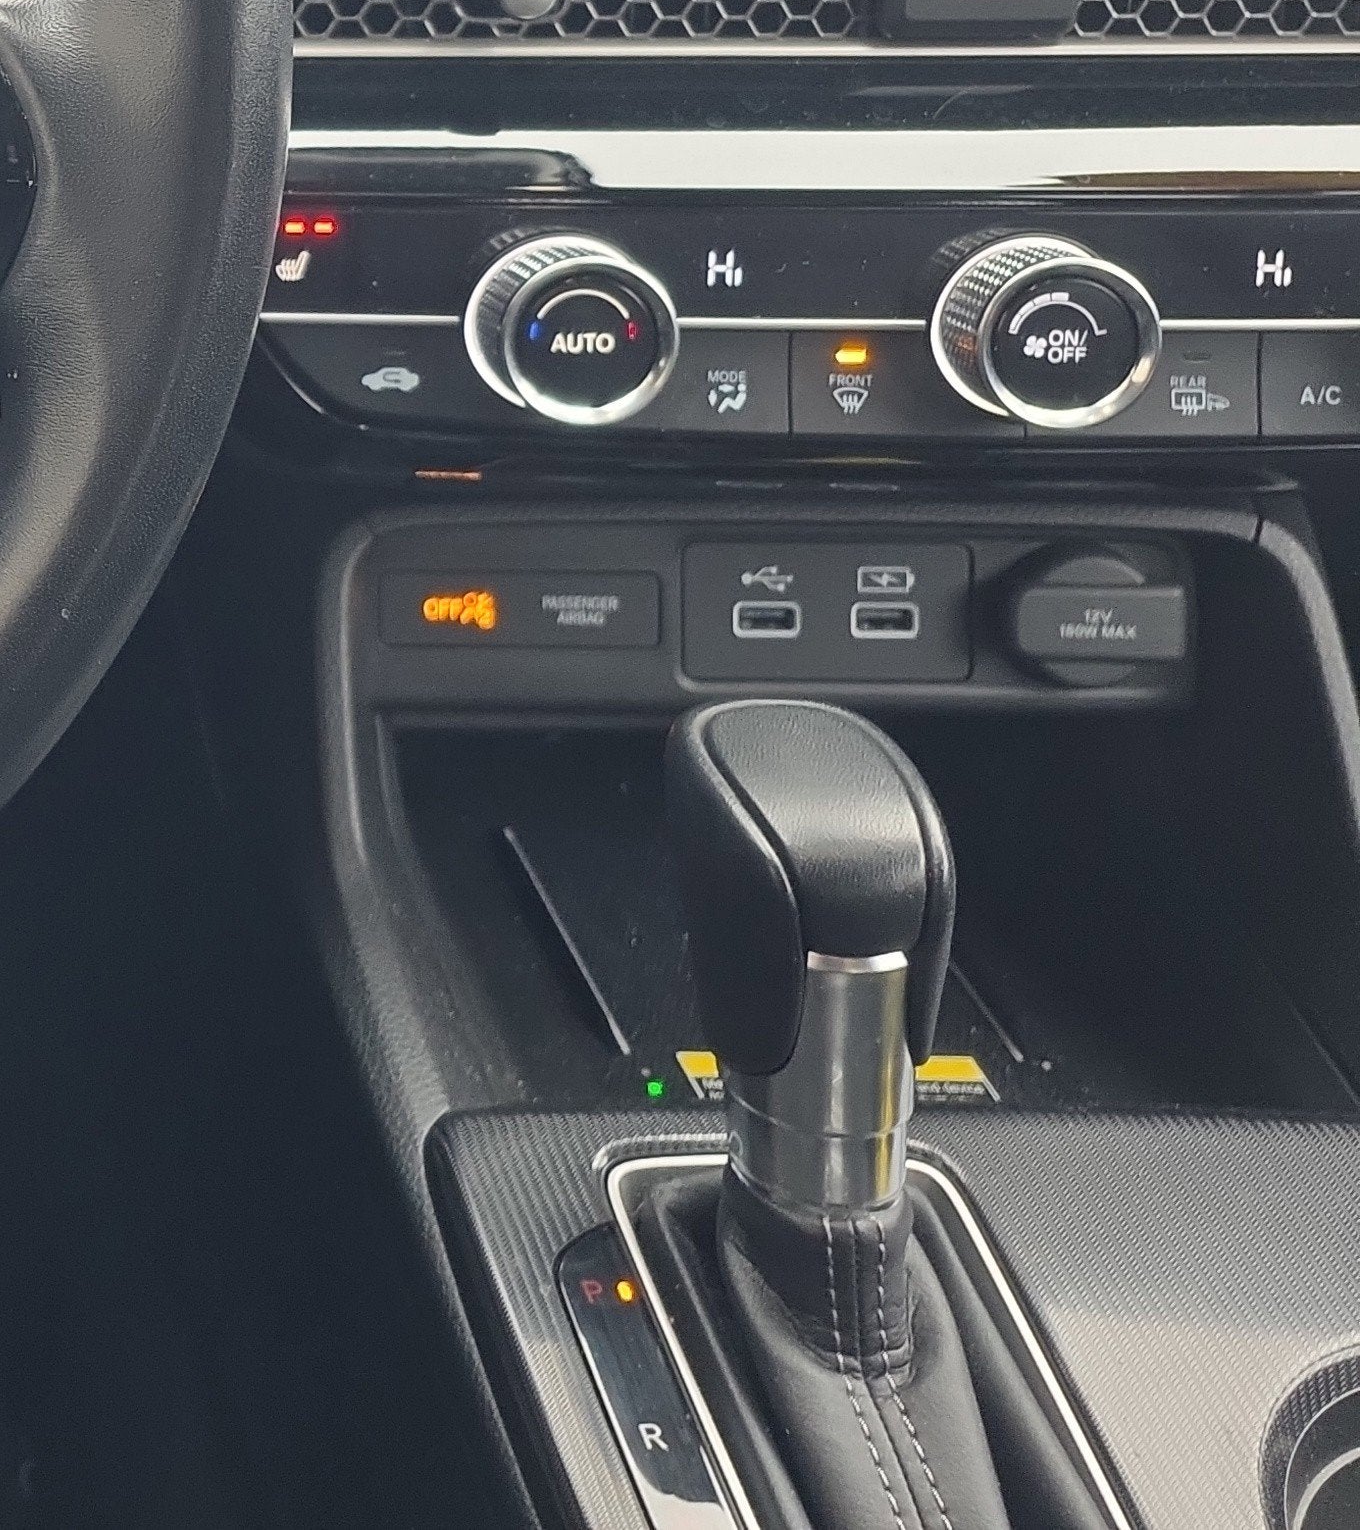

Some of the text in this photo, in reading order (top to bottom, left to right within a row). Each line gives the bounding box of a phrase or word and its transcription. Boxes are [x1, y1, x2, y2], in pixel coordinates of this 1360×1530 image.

[550, 334, 616, 354] AUTO
[1047, 329, 1087, 350] ON/
[1047, 346, 1087, 365] OFF
[707, 370, 747, 384] MODE
[829, 374, 873, 388] FRONT
[1170, 376, 1207, 388] REAR
[1300, 384, 1342, 406] A/C
[423, 597, 463, 621] OFF
[542, 595, 618, 611] PASSENGER
[1101, 623, 1137, 639] MAX
[581, 1280, 602, 1304] P
[638, 1423, 670, 1452] R
